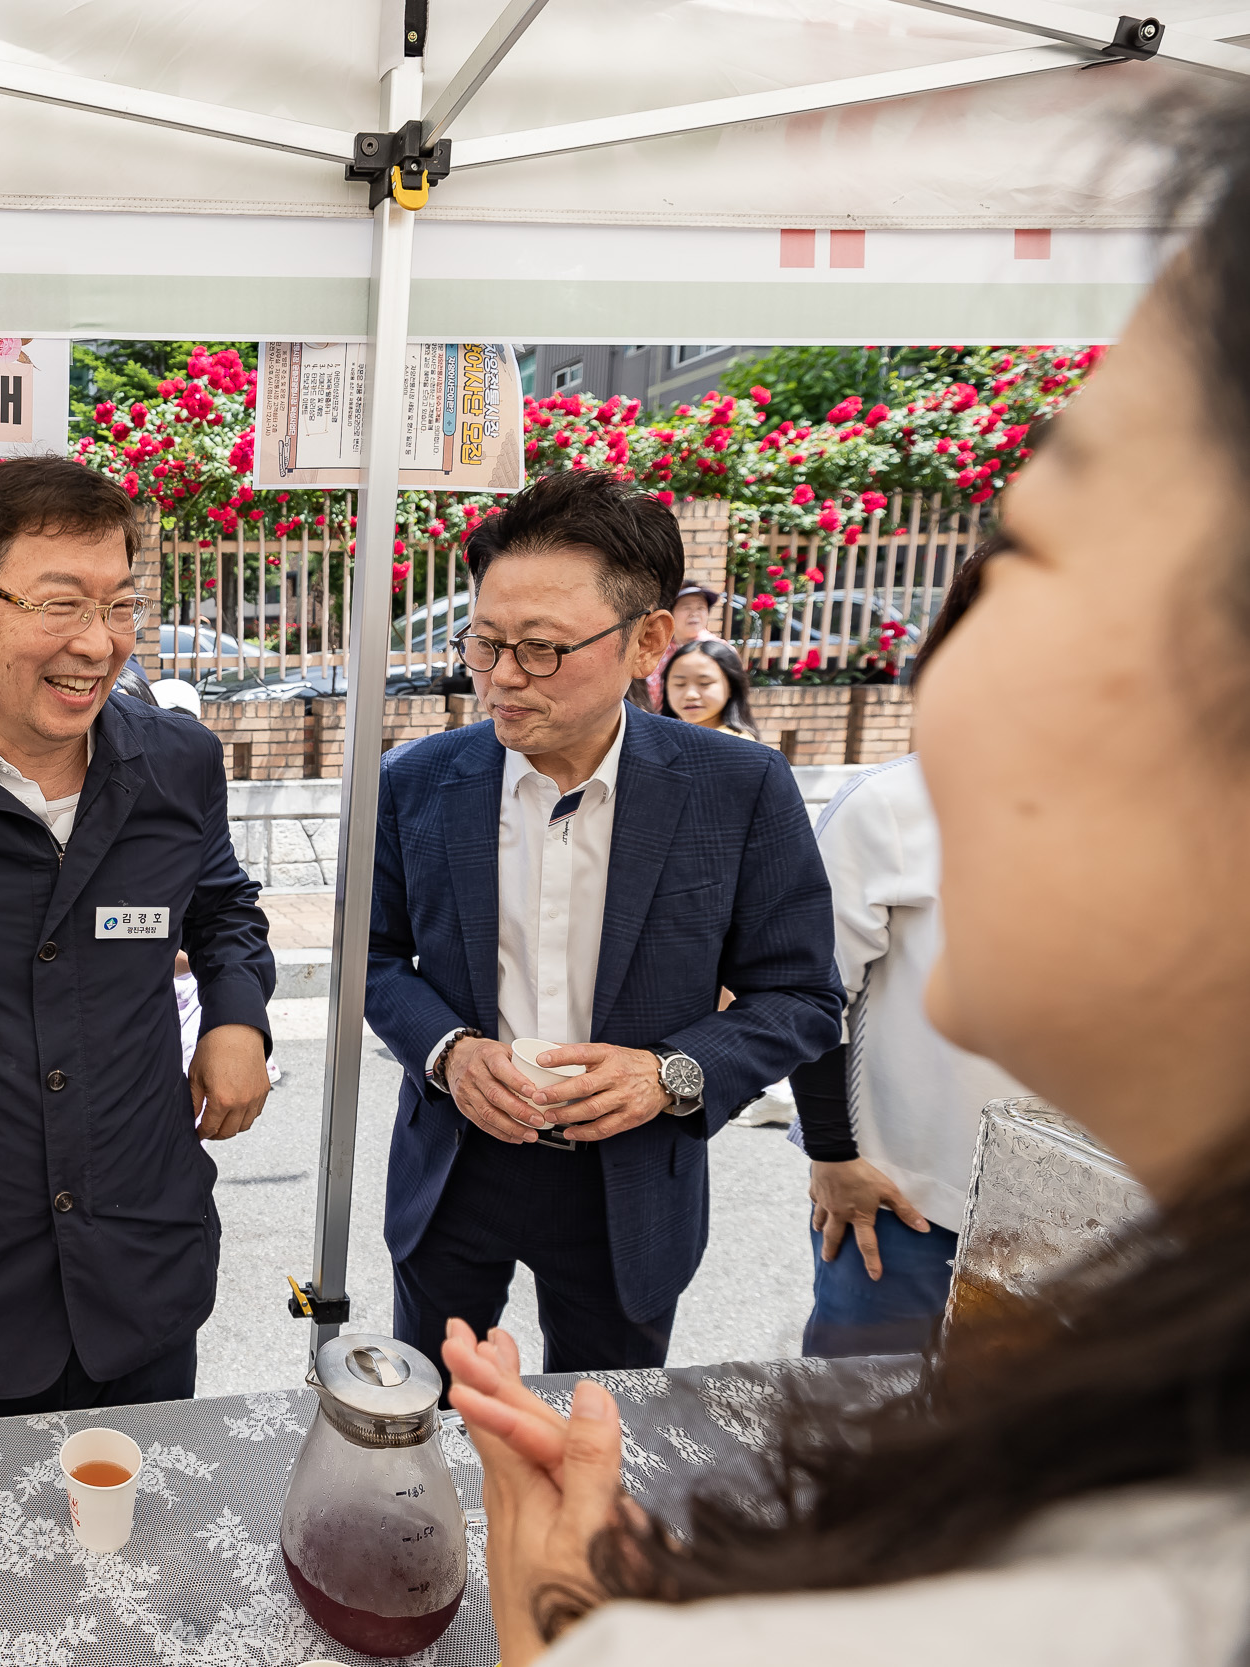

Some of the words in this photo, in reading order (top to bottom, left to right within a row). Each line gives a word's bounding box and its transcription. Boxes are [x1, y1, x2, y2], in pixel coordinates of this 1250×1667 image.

[446, 356, 456, 413] 자양어사단이란?
[483, 343, 501, 438] 자양전통시장
[461, 422, 482, 465] 모집
[127, 926, 157, 934] 광진구청장
